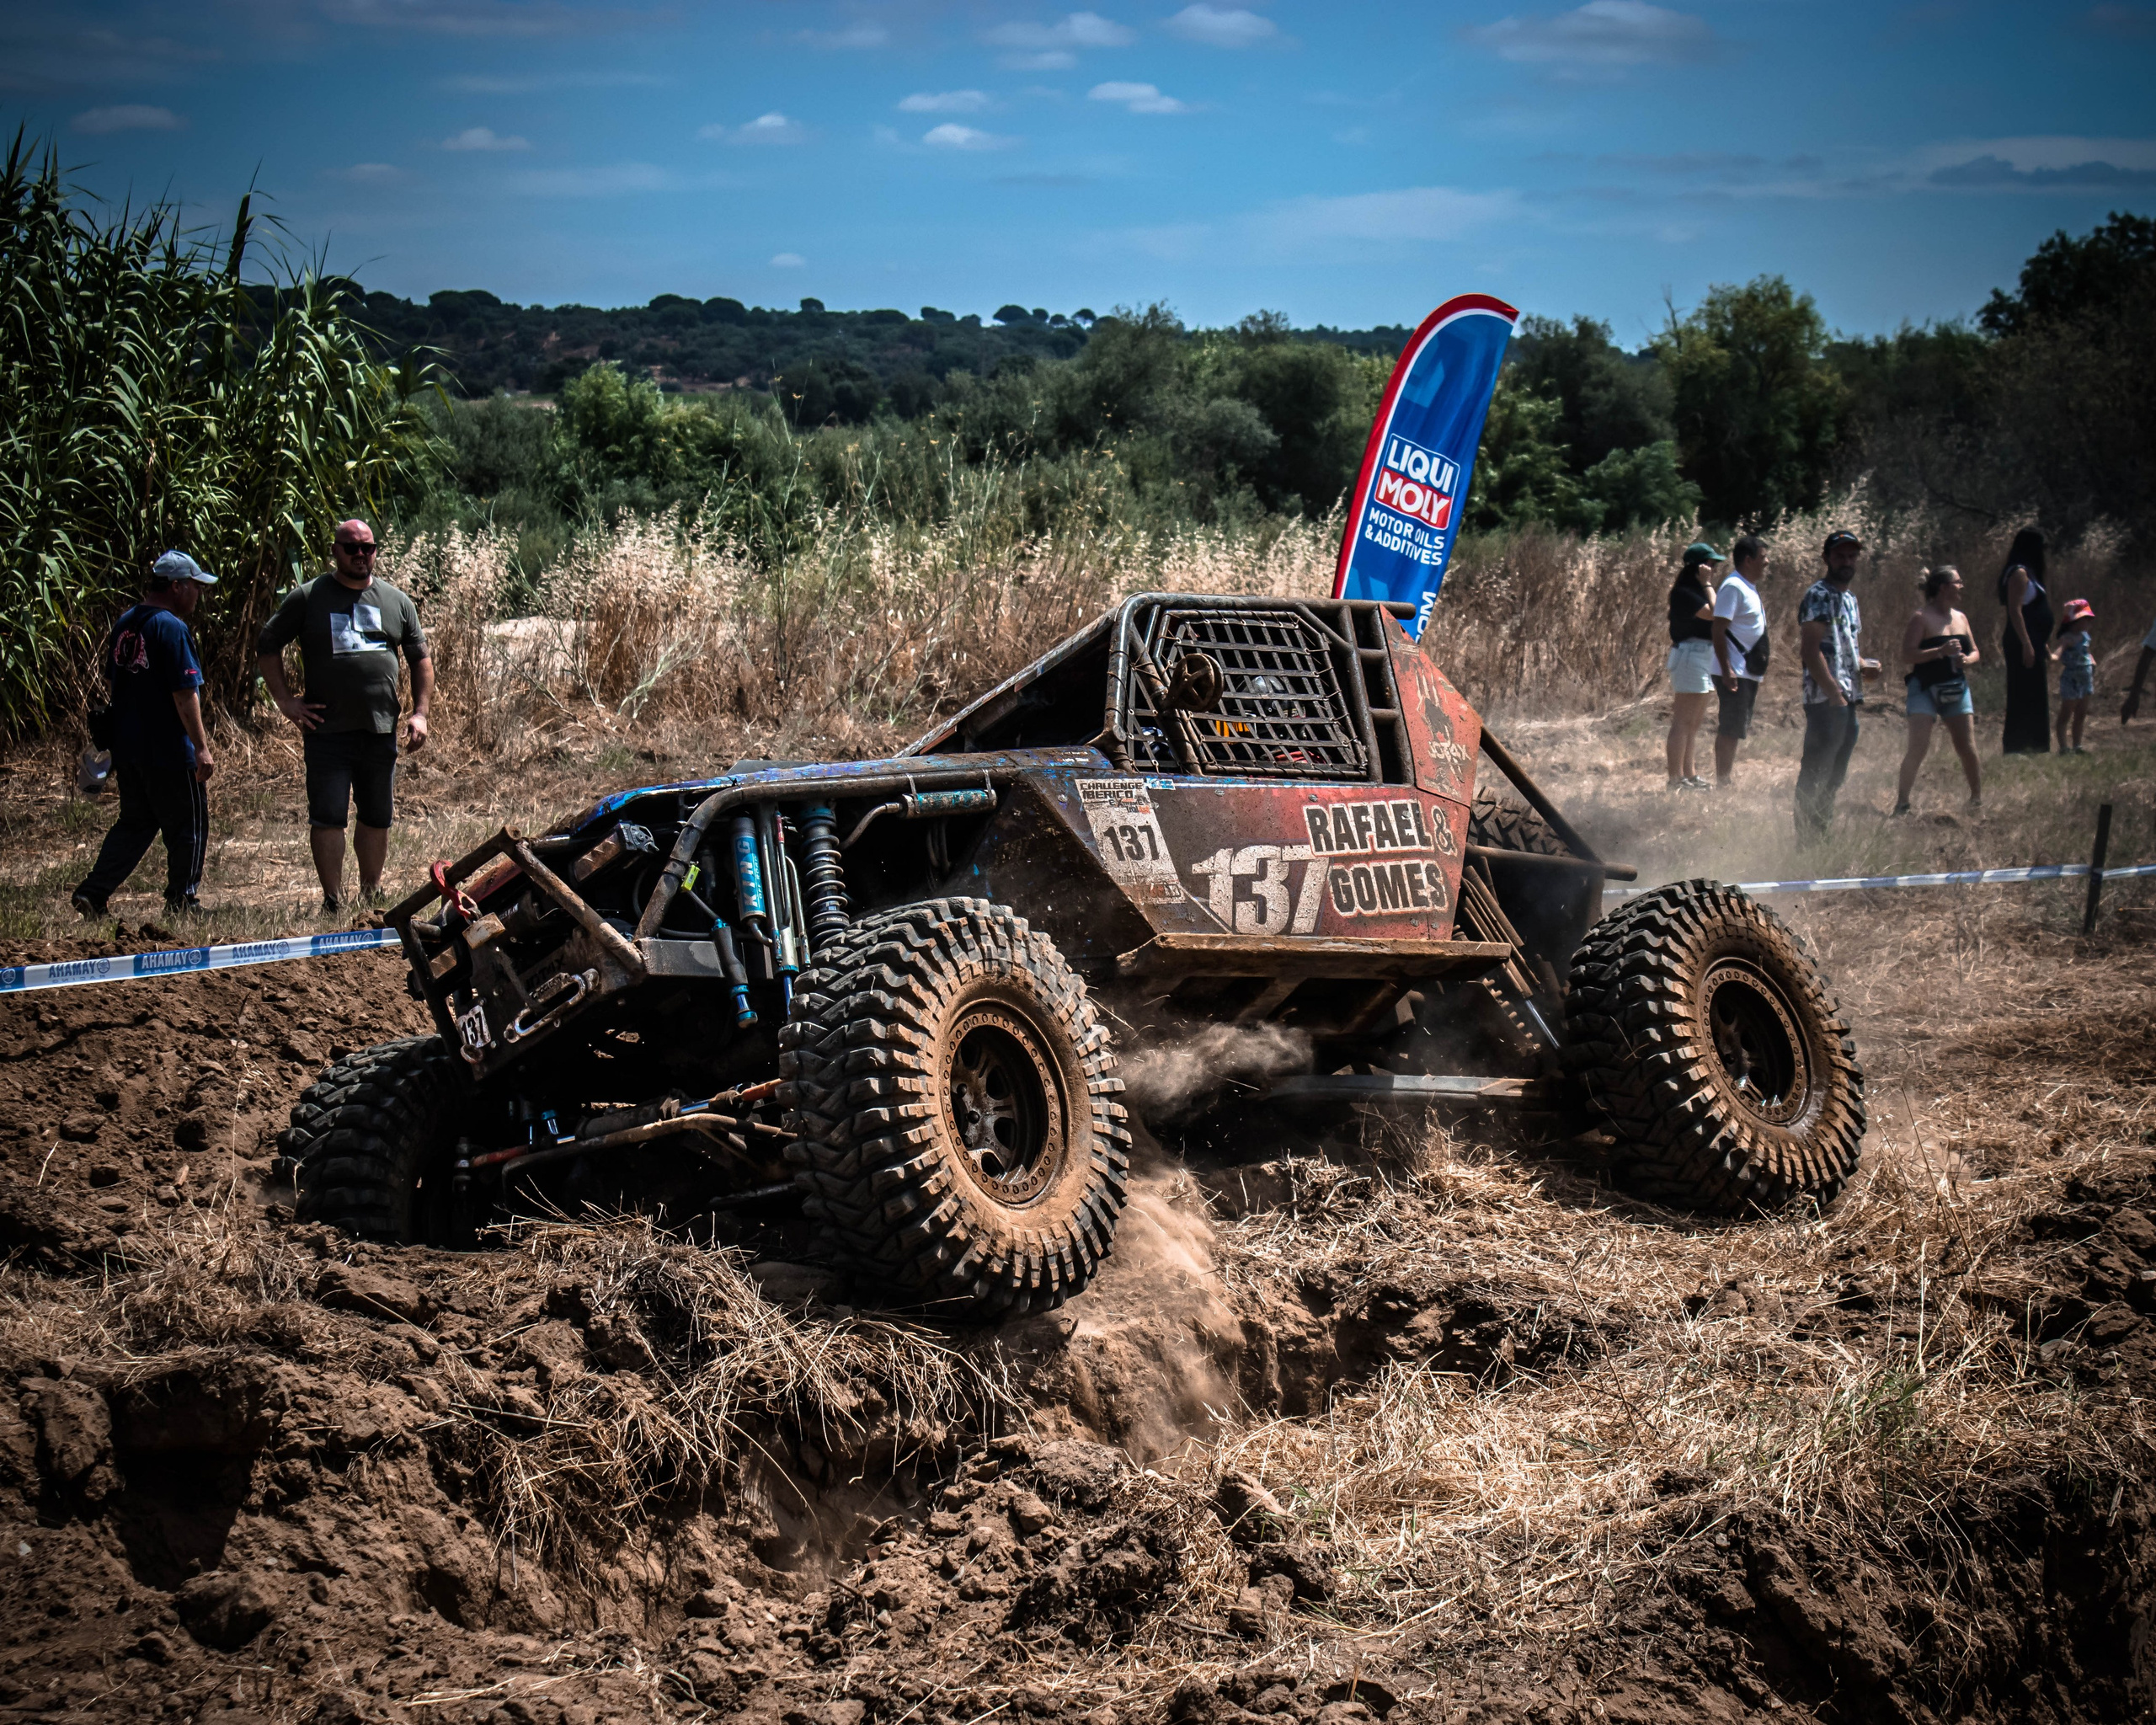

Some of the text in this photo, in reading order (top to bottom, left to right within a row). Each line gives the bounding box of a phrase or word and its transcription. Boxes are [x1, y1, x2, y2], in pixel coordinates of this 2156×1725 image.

[1387, 439, 1454, 494] LIQUI
[1378, 471, 1450, 524] MOLY
[1369, 507, 1445, 550] MOTOR OILS
[1080, 782, 1143, 791] CHALLENGE
[1103, 825, 1161, 861] 137
[1303, 799, 1457, 857] RAFAEL &
[737, 841, 758, 907] KING
[1192, 845, 1330, 935] 137
[1329, 860, 1449, 916] GOMES
[462, 1011, 487, 1044] 137
